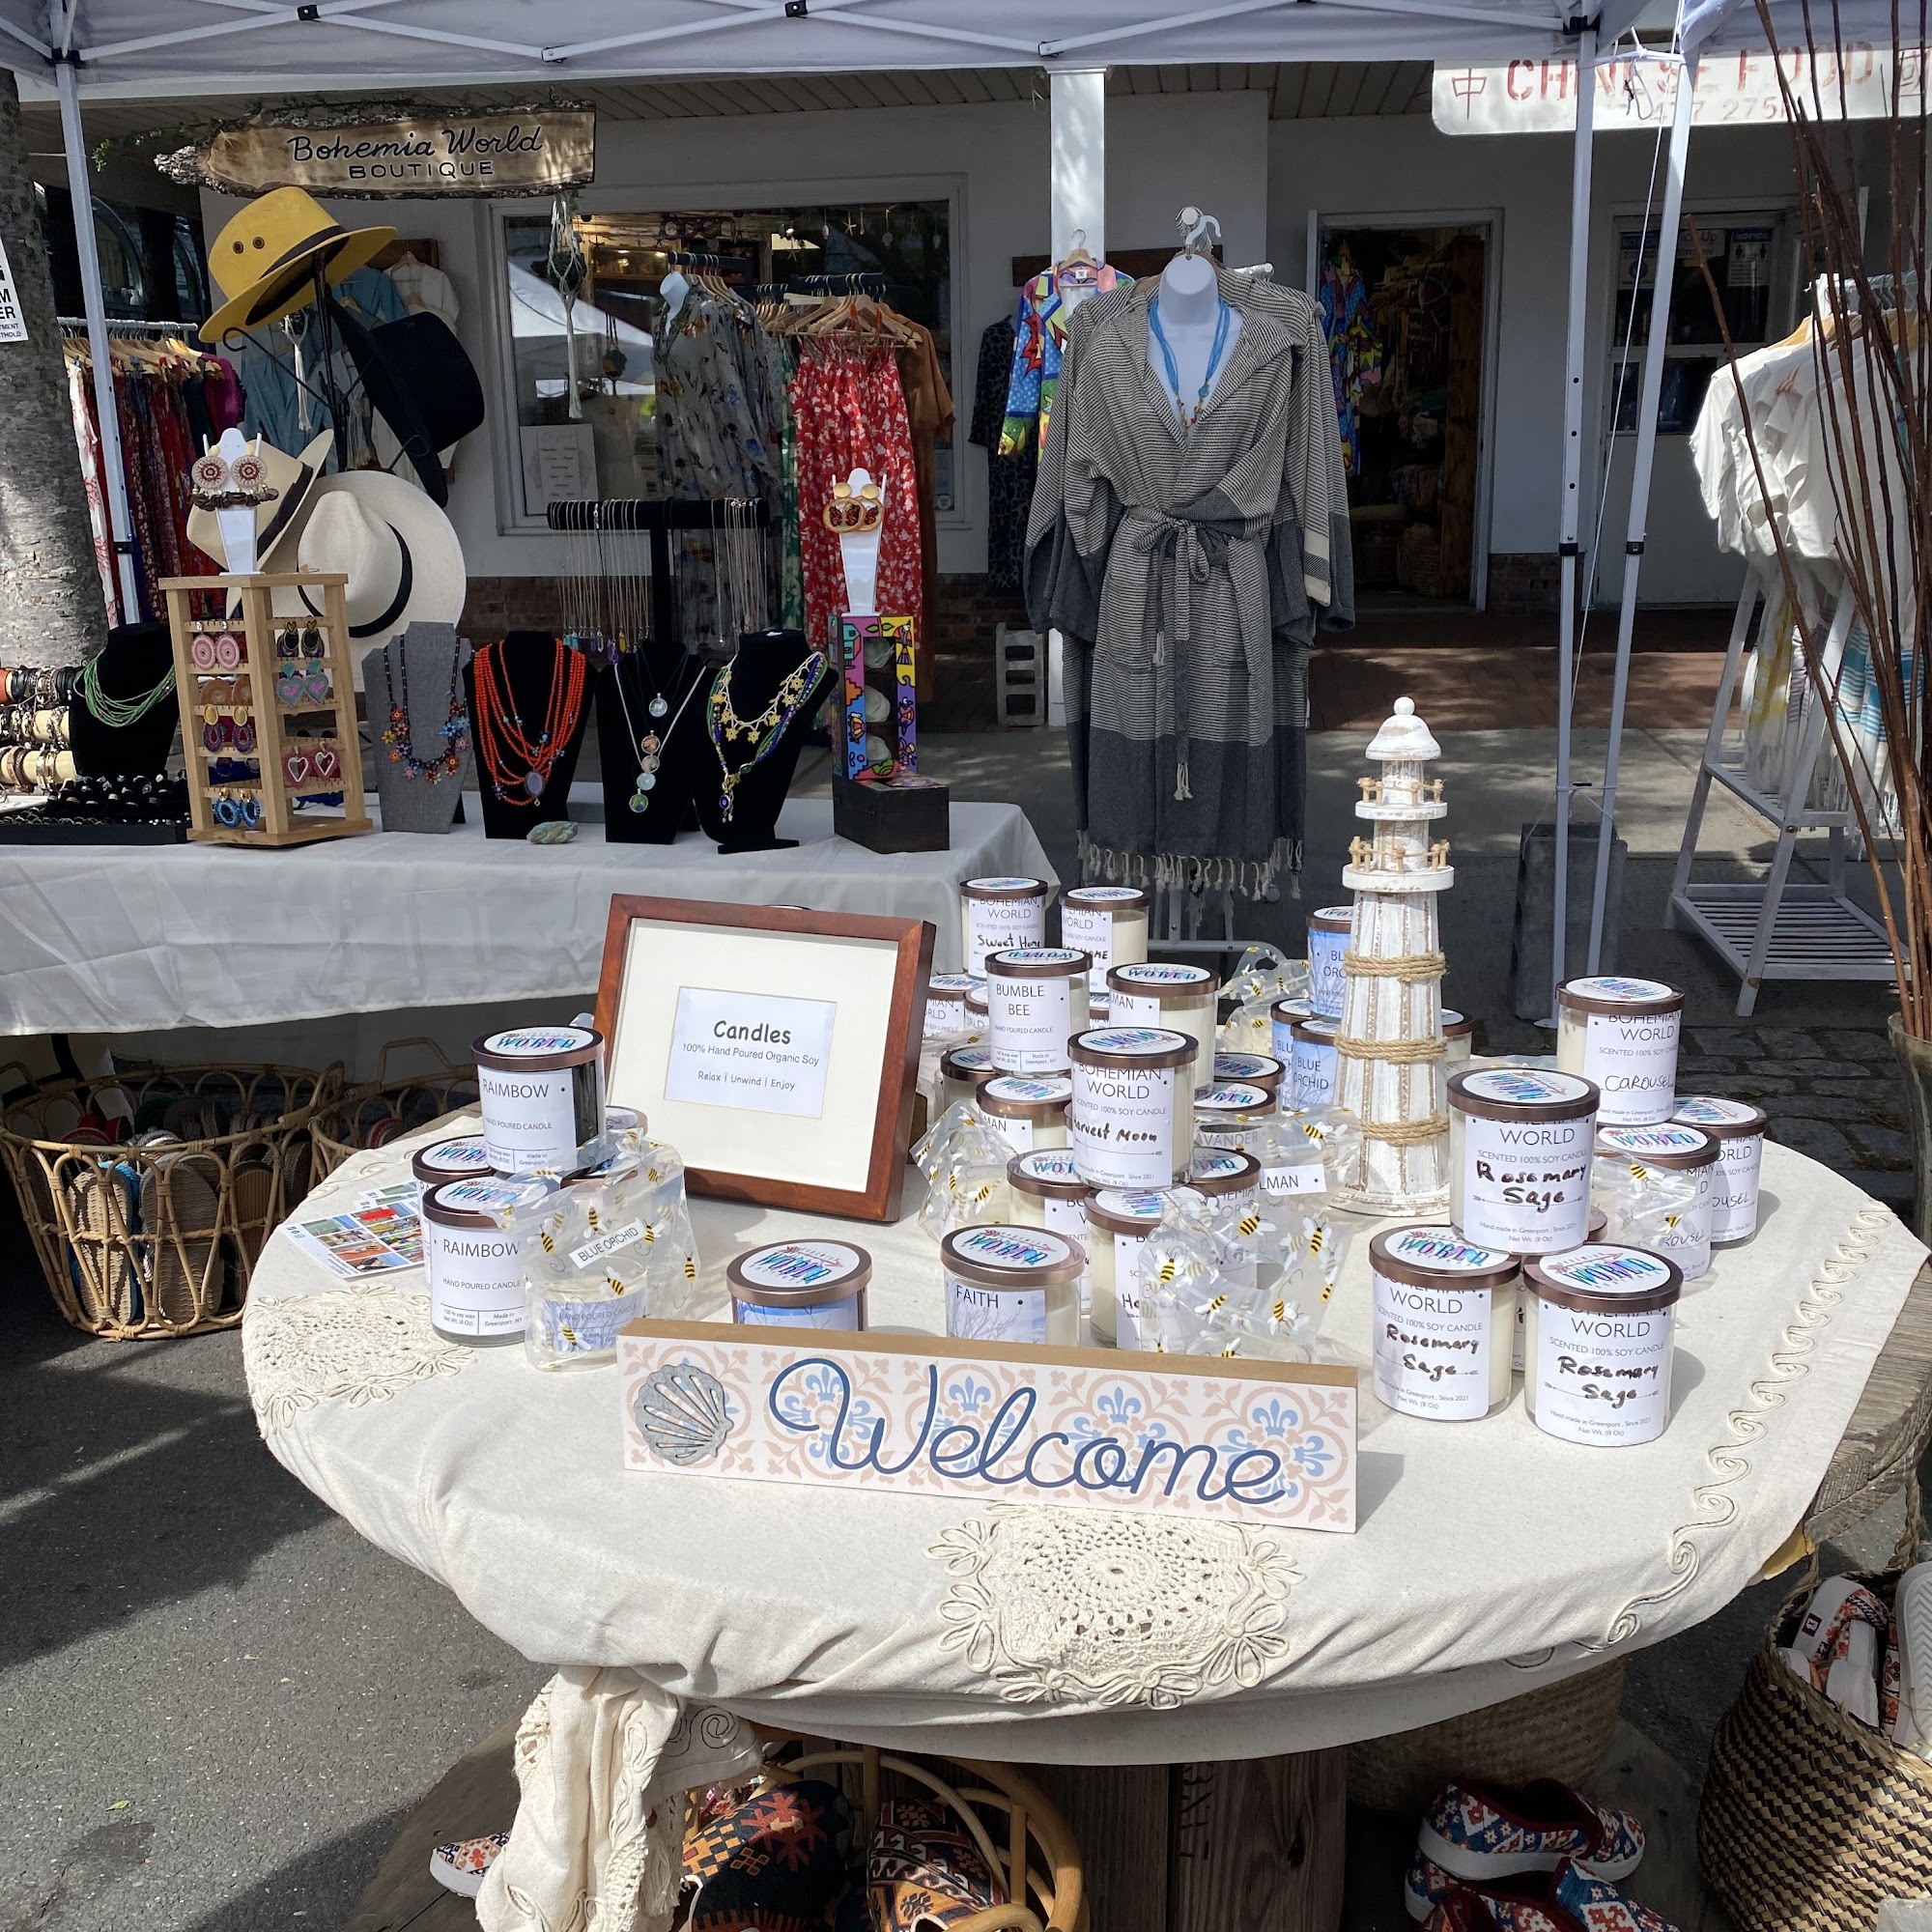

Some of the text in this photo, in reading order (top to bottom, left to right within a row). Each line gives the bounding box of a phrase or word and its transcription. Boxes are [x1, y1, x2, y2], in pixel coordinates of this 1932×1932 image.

[1507, 59, 1722, 100] CHNESE
[287, 126, 543, 162] Bohemia World
[349, 161, 494, 180] BOUTIQUE
[987, 909, 1032, 919] WORLD
[977, 933, 1014, 948] Sweet
[1331, 951, 1345, 961] BL
[1323, 966, 1347, 978] ORC
[996, 984, 1044, 997] BUMBLE
[1009, 1004, 1030, 1015] BEE
[713, 1020, 791, 1044] Candles
[1620, 1025, 1675, 1041] WORLD
[683, 1043, 819, 1066] 100% Hand Poured Organic Soy
[1278, 1040, 1293, 1053] BLU
[1599, 1046, 1634, 1057] SCENTED
[1635, 1048, 1652, 1057] 100%
[1297, 1056, 1321, 1072] BLUE
[483, 1078, 550, 1098] RAIMBOW
[697, 1070, 795, 1092] Relax Unwind Enjoy
[1087, 1079, 1151, 1099] WORLD
[1293, 1072, 1329, 1090] ORCHID
[1100, 1103, 1117, 1114] 100%
[497, 1121, 523, 1130] POURED
[1194, 1132, 1258, 1147] AVANDER
[1499, 1128, 1576, 1146] WORLD
[1478, 1150, 1587, 1163] SCENTED 100% SOY CANDLE
[1717, 1146, 1752, 1162] ORLD
[443, 1238, 521, 1258] RAIMBOW
[578, 1226, 639, 1263] BLUE ORCHID
[1398, 1236, 1490, 1265] WORLD
[442, 1277, 521, 1290] HAND POURED CANDLE
[956, 1285, 999, 1309] FAITH
[1390, 1288, 1463, 1314] WORLD
[1378, 1304, 1483, 1332] SCENTED 100% SOY CANDLE
[1571, 1318, 1651, 1338] WORLD
[1549, 1337, 1588, 1354] SCENTED
[1592, 1348, 1613, 1356] 100%
[1635, 1343, 1664, 1355] CANDLE
[1406, 1388, 1435, 1401] Greenport
[1550, 1409, 1564, 1419] Hand
[1566, 1414, 1581, 1423] made
[1589, 1420, 1620, 1430] Greenport
[770, 1357, 1287, 1507] Welcome
